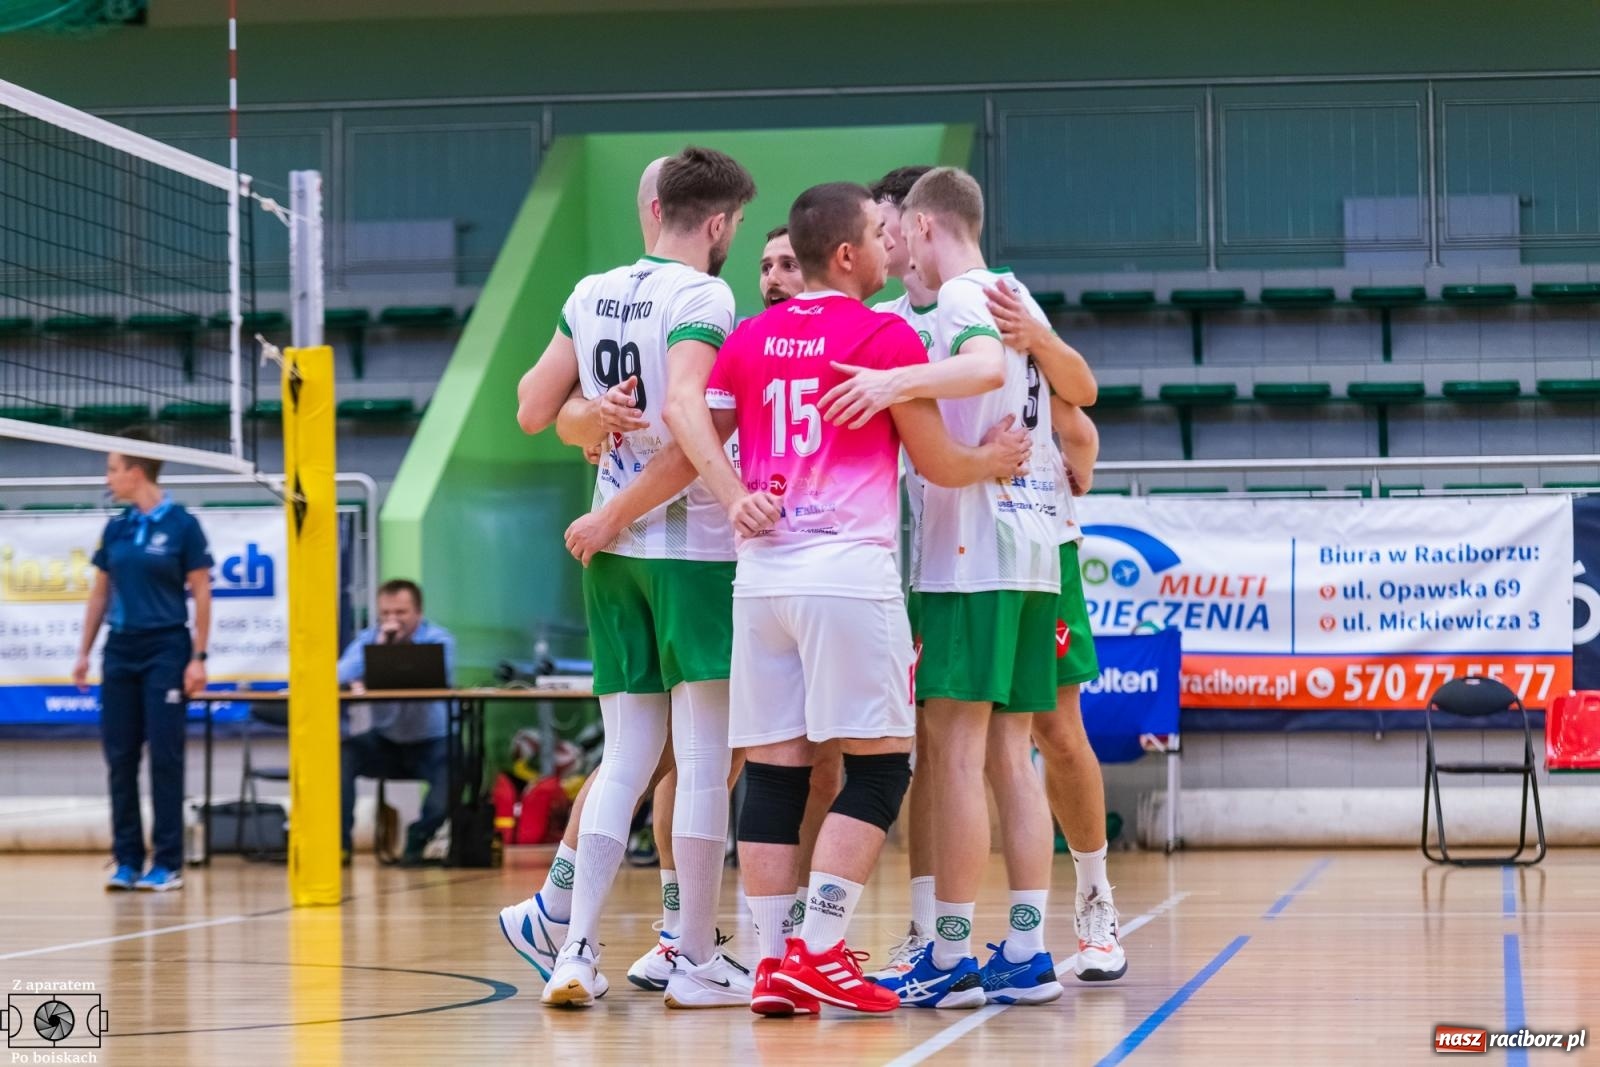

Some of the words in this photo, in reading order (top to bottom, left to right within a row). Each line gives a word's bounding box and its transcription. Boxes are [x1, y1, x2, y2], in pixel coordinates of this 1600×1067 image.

[763, 336, 826, 359] KOSTKA
[762, 377, 822, 458] 15
[1319, 544, 1381, 565] Biura
[1388, 549, 1408, 563] w
[1415, 543, 1541, 564] Raciborzu:
[1159, 575, 1268, 599] MULTI
[1343, 579, 1372, 600] ul.
[1379, 578, 1487, 604] Opawska
[1494, 578, 1521, 599] 69
[1343, 611, 1372, 632] ul.
[1379, 609, 1521, 632] Mickiewicza
[1528, 610, 1542, 630] 3
[1180, 669, 1297, 700] raciborz.pl
[1343, 663, 1407, 701] 570
[1514, 663, 1557, 701] 77
